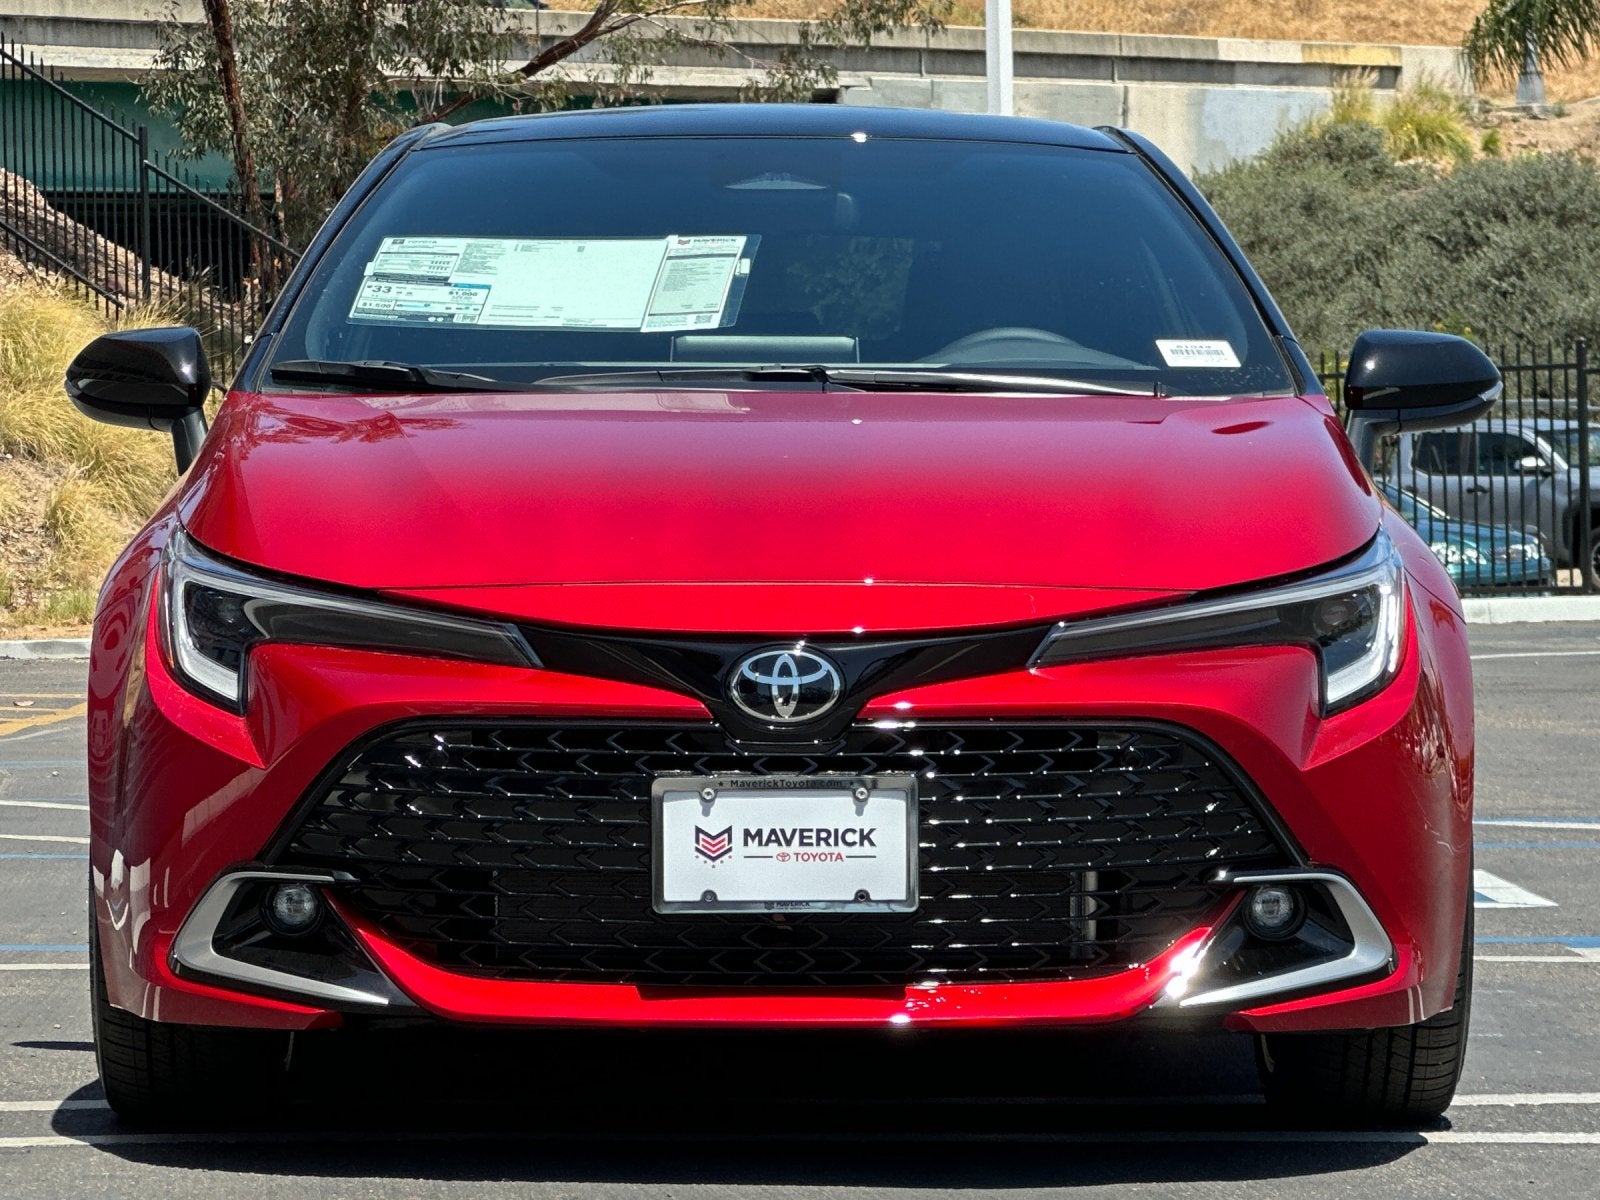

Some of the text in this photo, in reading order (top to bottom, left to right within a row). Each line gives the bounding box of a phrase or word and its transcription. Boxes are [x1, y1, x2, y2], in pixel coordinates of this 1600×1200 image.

[372, 286, 392, 294] 33
[730, 779, 843, 788] MaverickToyota.com
[743, 828, 876, 847] MAVERICK
[793, 852, 844, 862] TOYOTA
